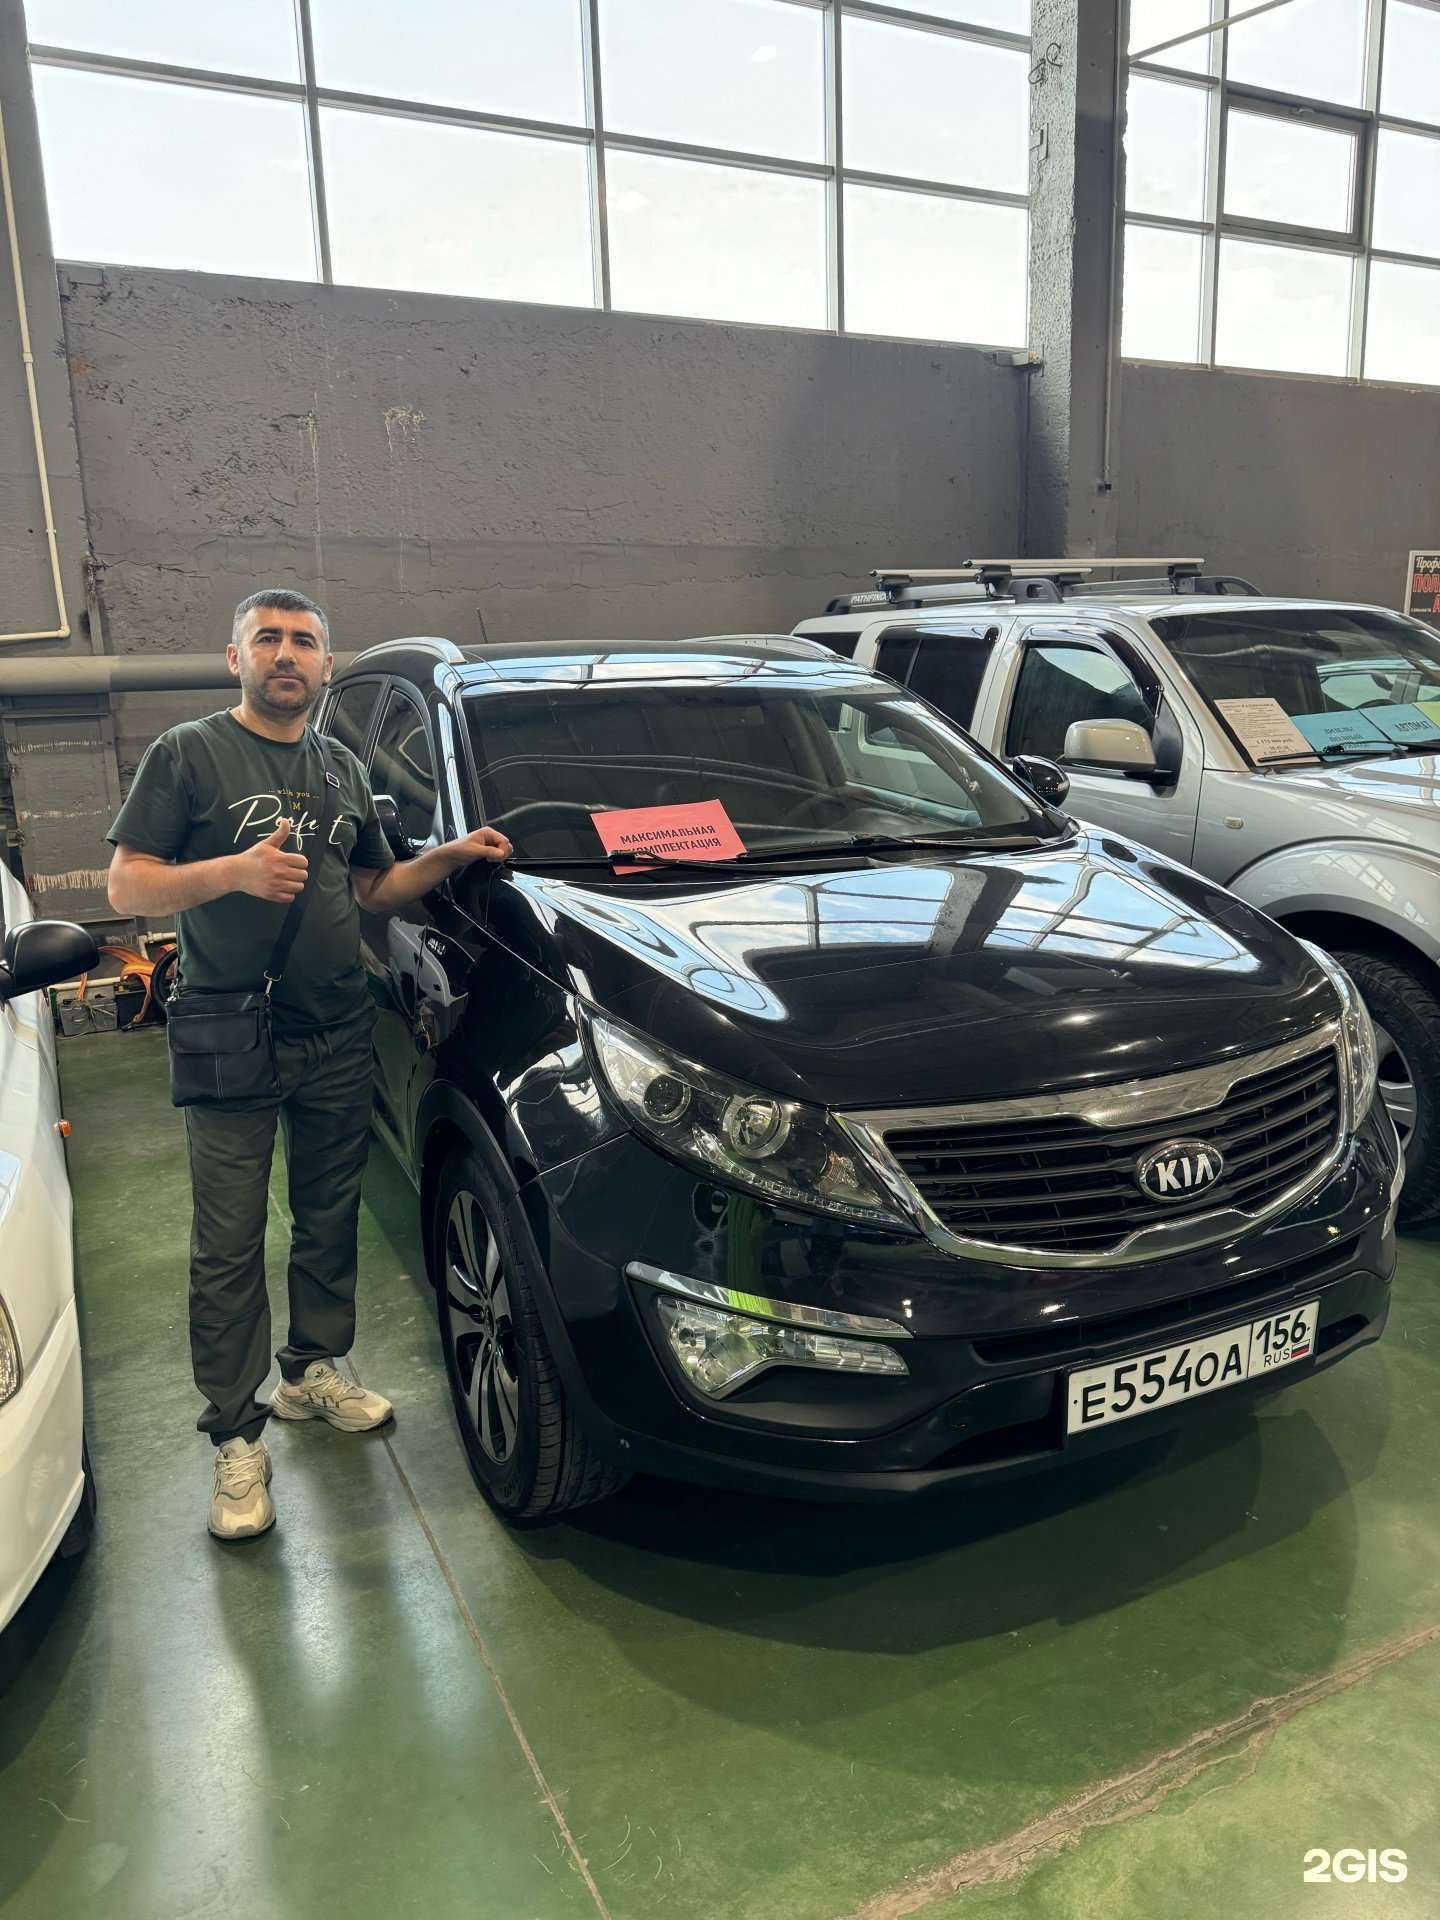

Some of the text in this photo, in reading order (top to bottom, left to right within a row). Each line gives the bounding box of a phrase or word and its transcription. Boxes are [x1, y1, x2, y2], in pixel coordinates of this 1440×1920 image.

[227, 794, 353, 852] Perfet
[620, 825, 716, 845] МАКСИМАЛЬНАЯ
[630, 838, 721, 856] ОМПЛЕКТАЦИЯ
[1155, 1153, 1214, 1192] KIA
[1255, 1309, 1308, 1355] 156
[1263, 1347, 1290, 1368] RUS
